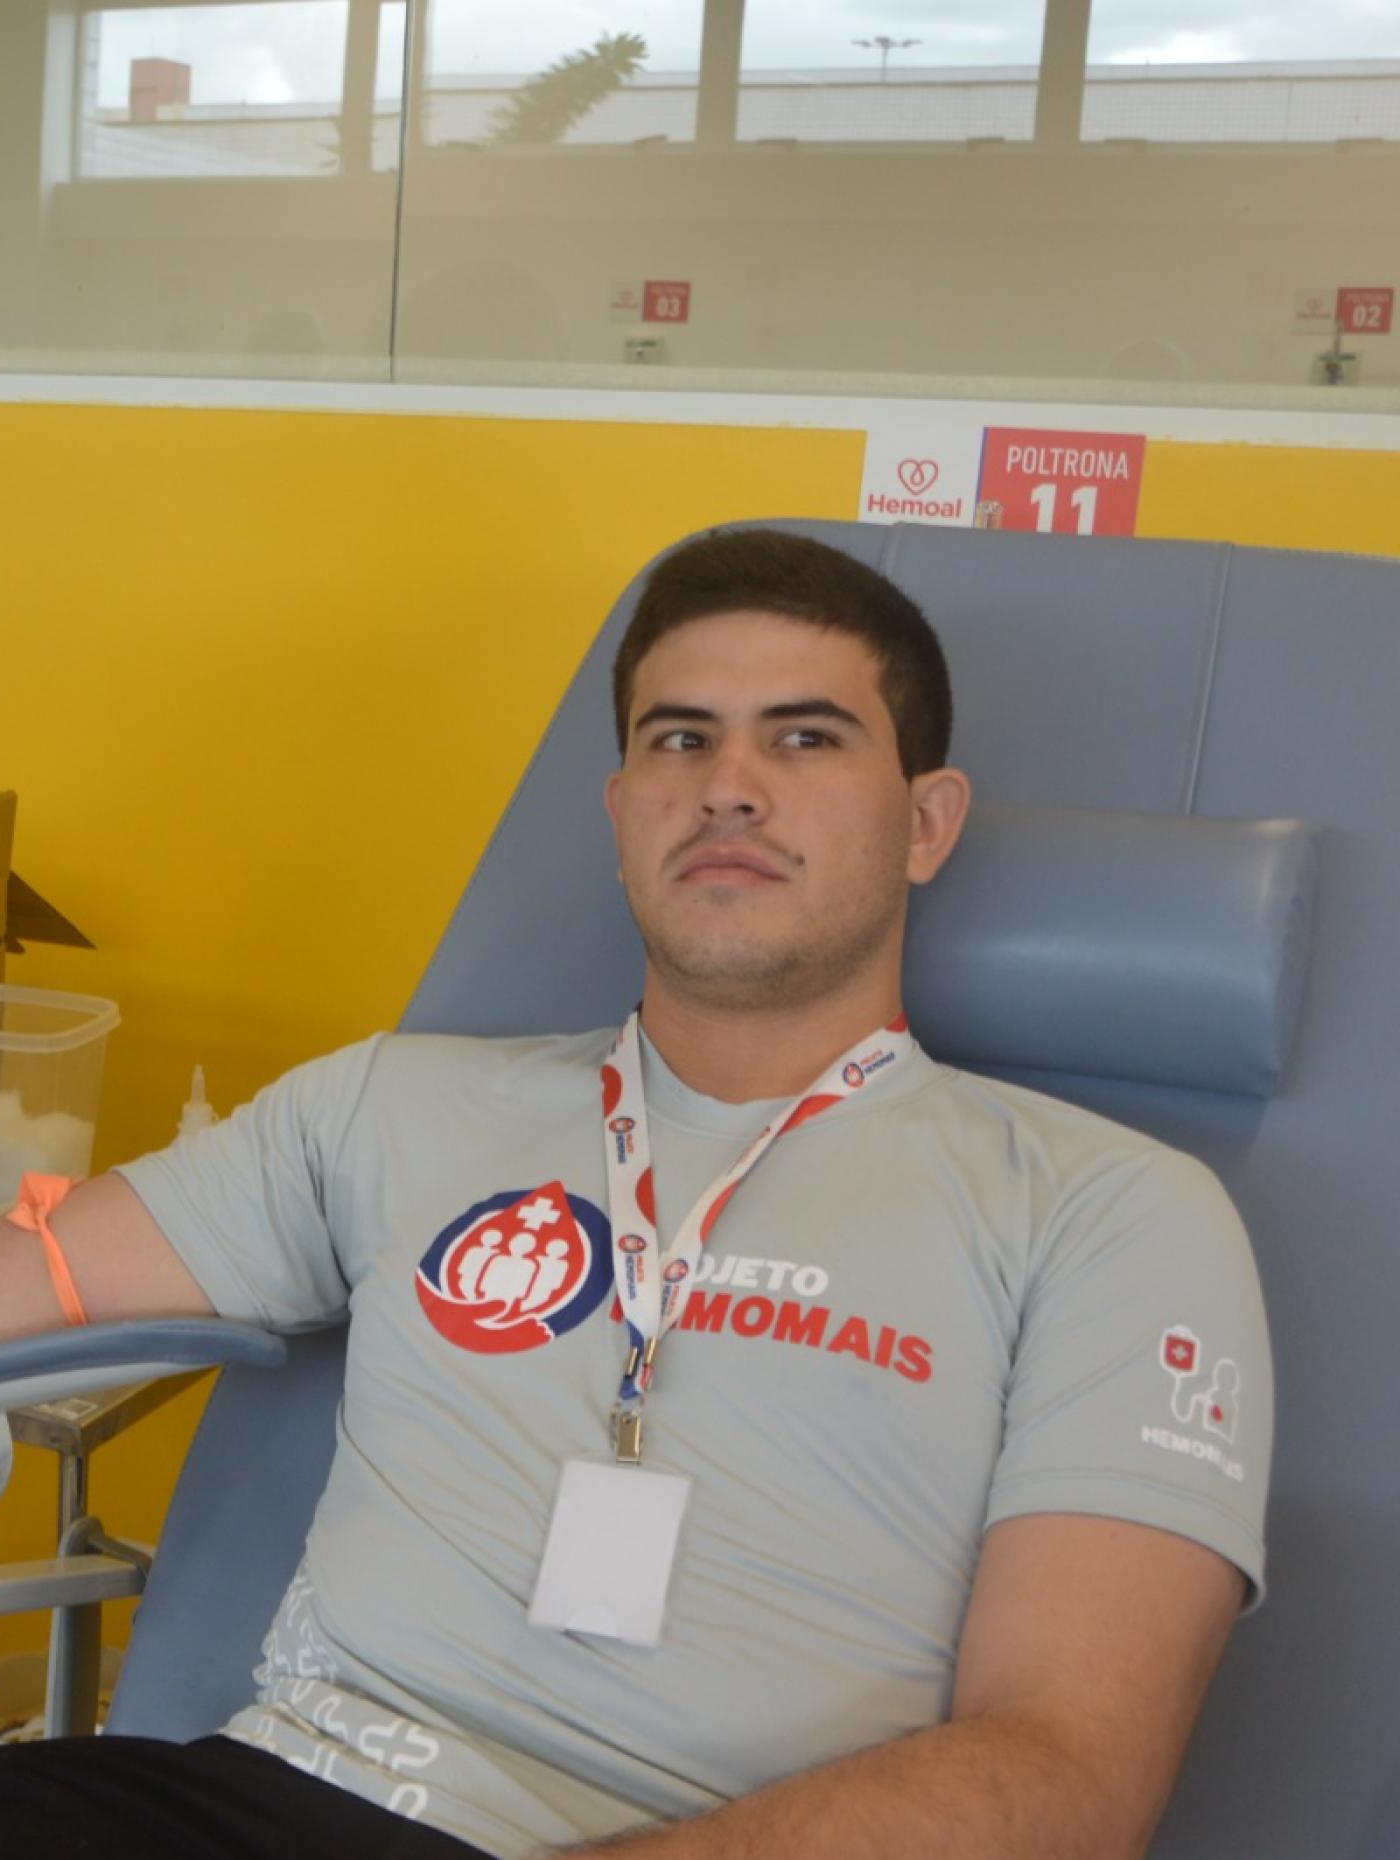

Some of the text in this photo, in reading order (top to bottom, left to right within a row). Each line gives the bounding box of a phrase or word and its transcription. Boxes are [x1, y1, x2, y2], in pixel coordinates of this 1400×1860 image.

[656, 296, 681, 319] 03
[1351, 304, 1382, 328] 02
[1005, 444, 1130, 480] POLTRONA
[866, 492, 963, 519] Hemoal
[1029, 482, 1098, 536] 11
[609, 1290, 934, 1384] MOMAIS
